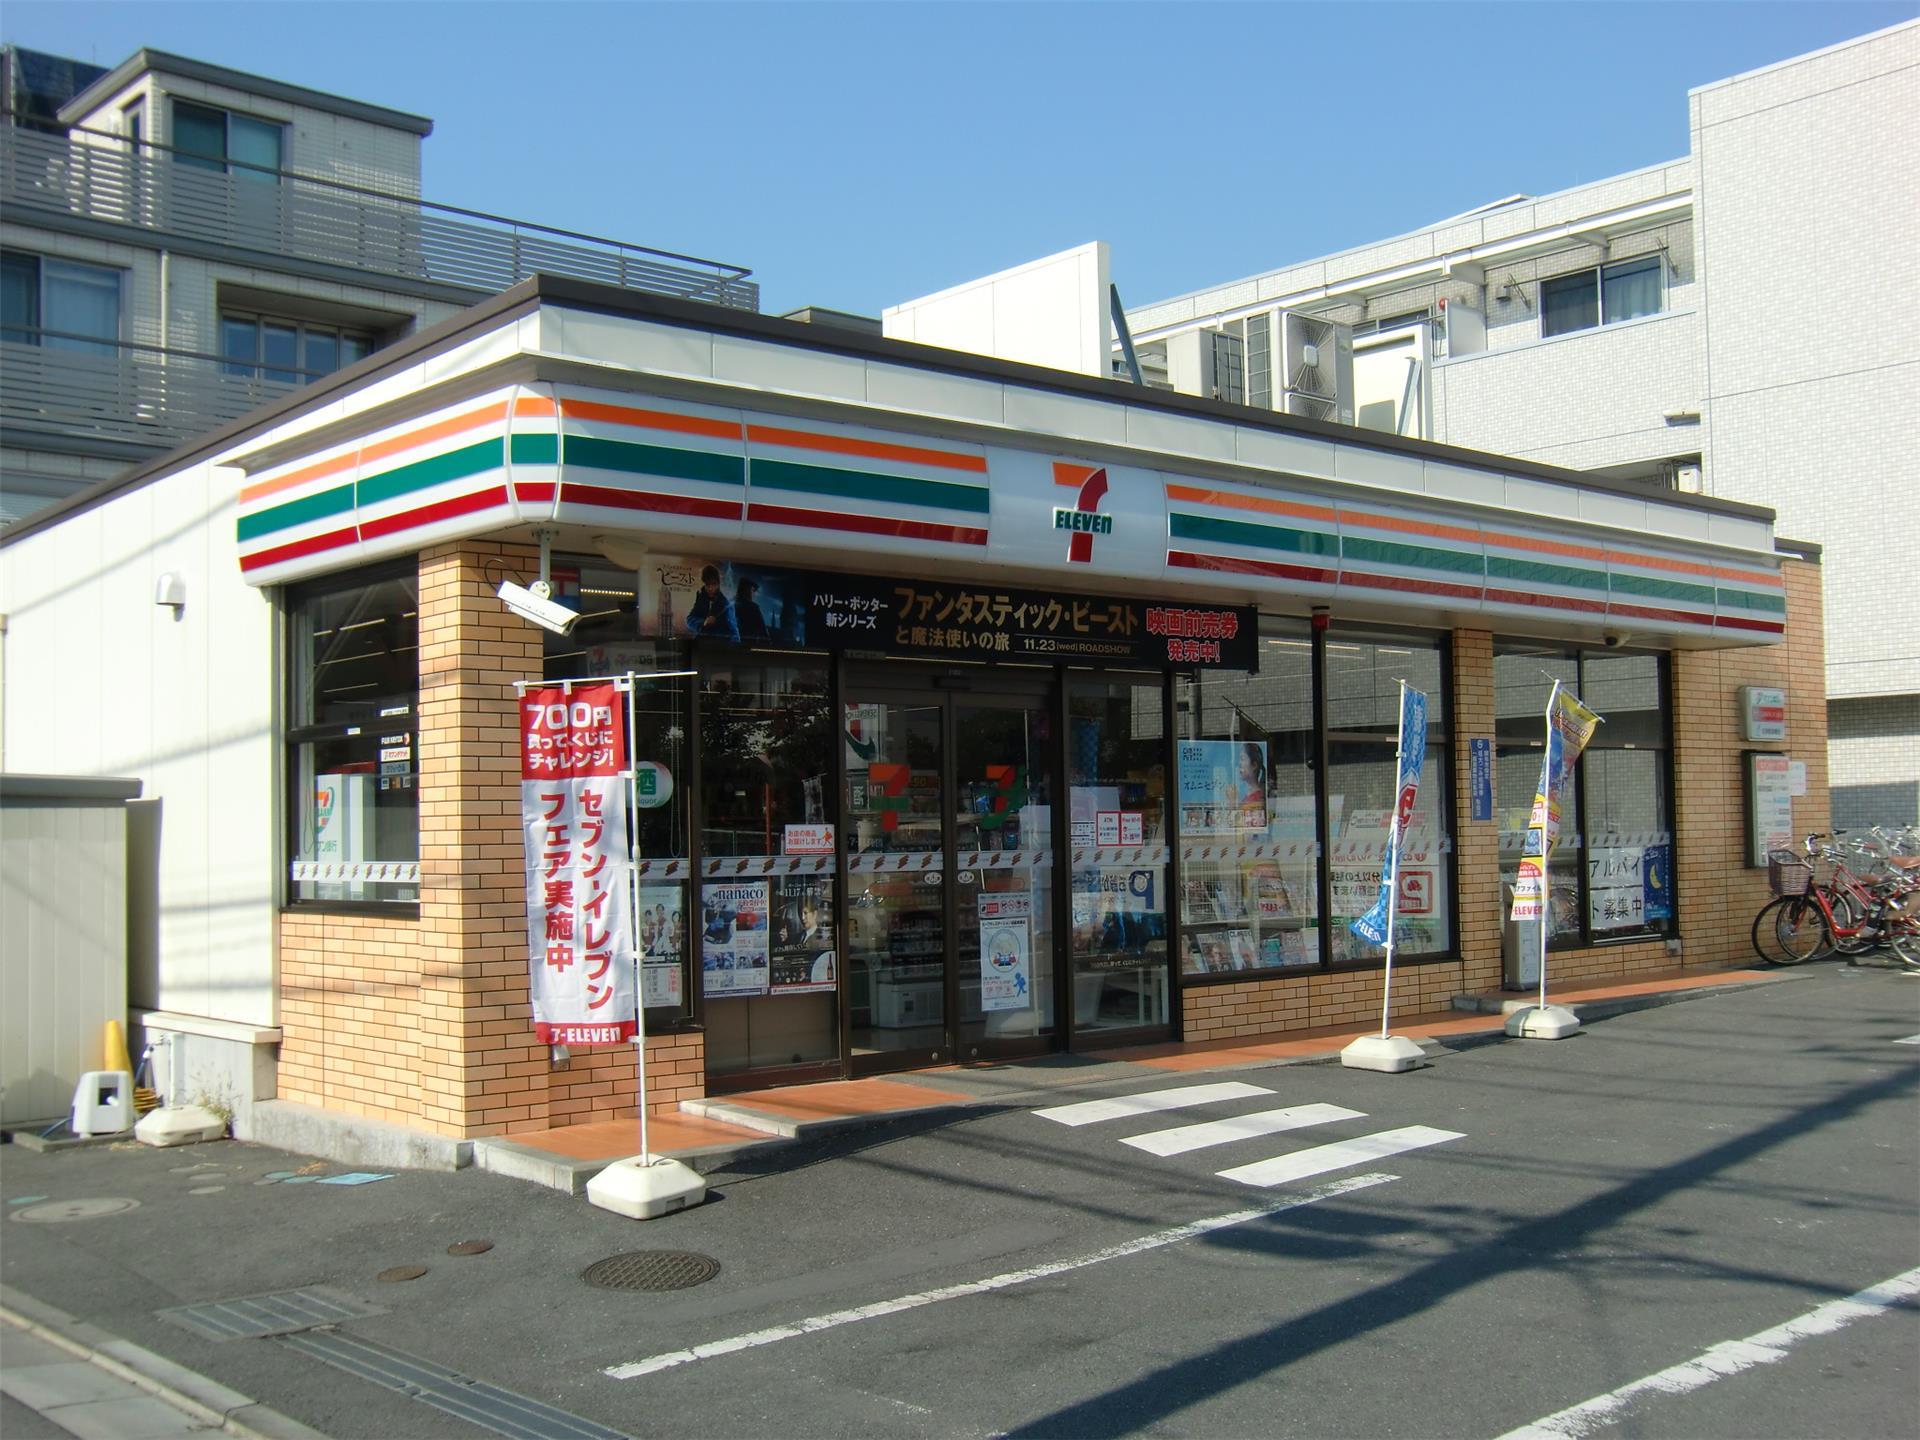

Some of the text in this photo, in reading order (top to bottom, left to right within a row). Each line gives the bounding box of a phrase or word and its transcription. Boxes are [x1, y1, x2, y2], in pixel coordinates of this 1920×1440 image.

[813, 593, 889, 612] ハリー・ポッター
[825, 611, 877, 630] 新シリーズ
[1146, 608, 1239, 639] 映画前売券
[895, 627, 1010, 652] と魔法使いの旅
[527, 702, 613, 730] 700円
[1590, 857, 1641, 879] アルバイ
[540, 793, 574, 973] フェア実施中
[718, 889, 763, 900] nanaco
[1591, 897, 1642, 919] ト募集中
